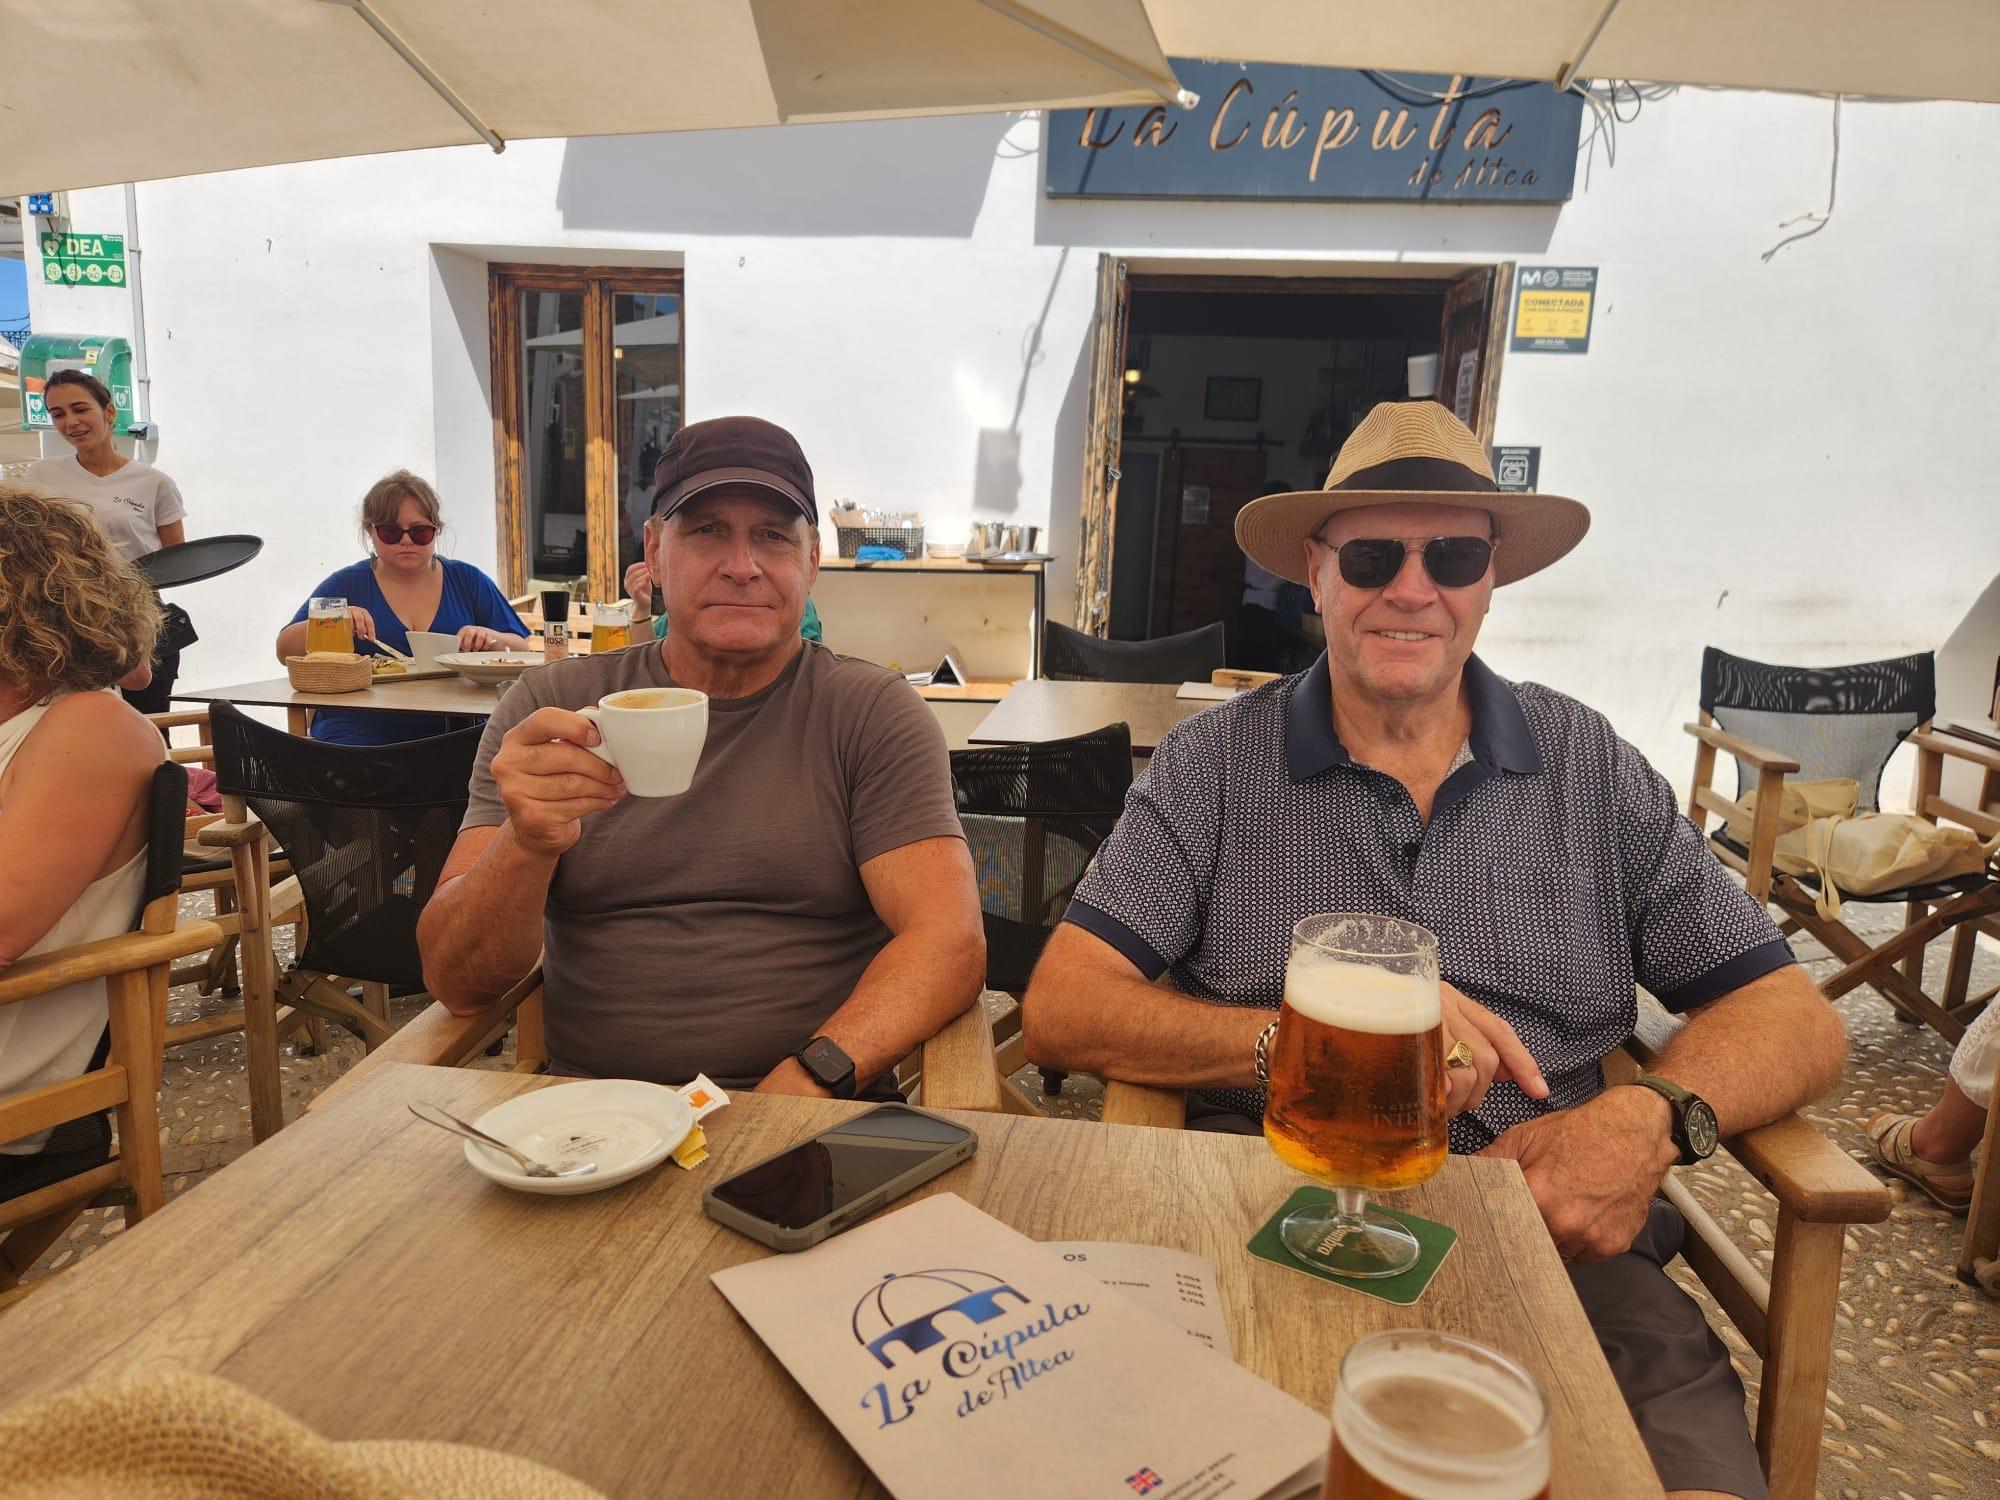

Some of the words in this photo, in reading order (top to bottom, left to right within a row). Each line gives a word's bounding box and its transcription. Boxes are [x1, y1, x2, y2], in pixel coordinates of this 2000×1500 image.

[1078, 105, 1179, 149] La
[1209, 77, 1513, 182] Cúpula
[1408, 156, 1445, 185] de
[1454, 157, 1538, 190] Altea
[66, 238, 105, 256] DEA
[31, 413, 47, 422] DEA
[1063, 1253, 1087, 1262] OS
[860, 1379, 931, 1430] La
[942, 1303, 1090, 1378] Cúpula
[957, 1390, 993, 1418] de
[987, 1350, 1075, 1399] Altea
